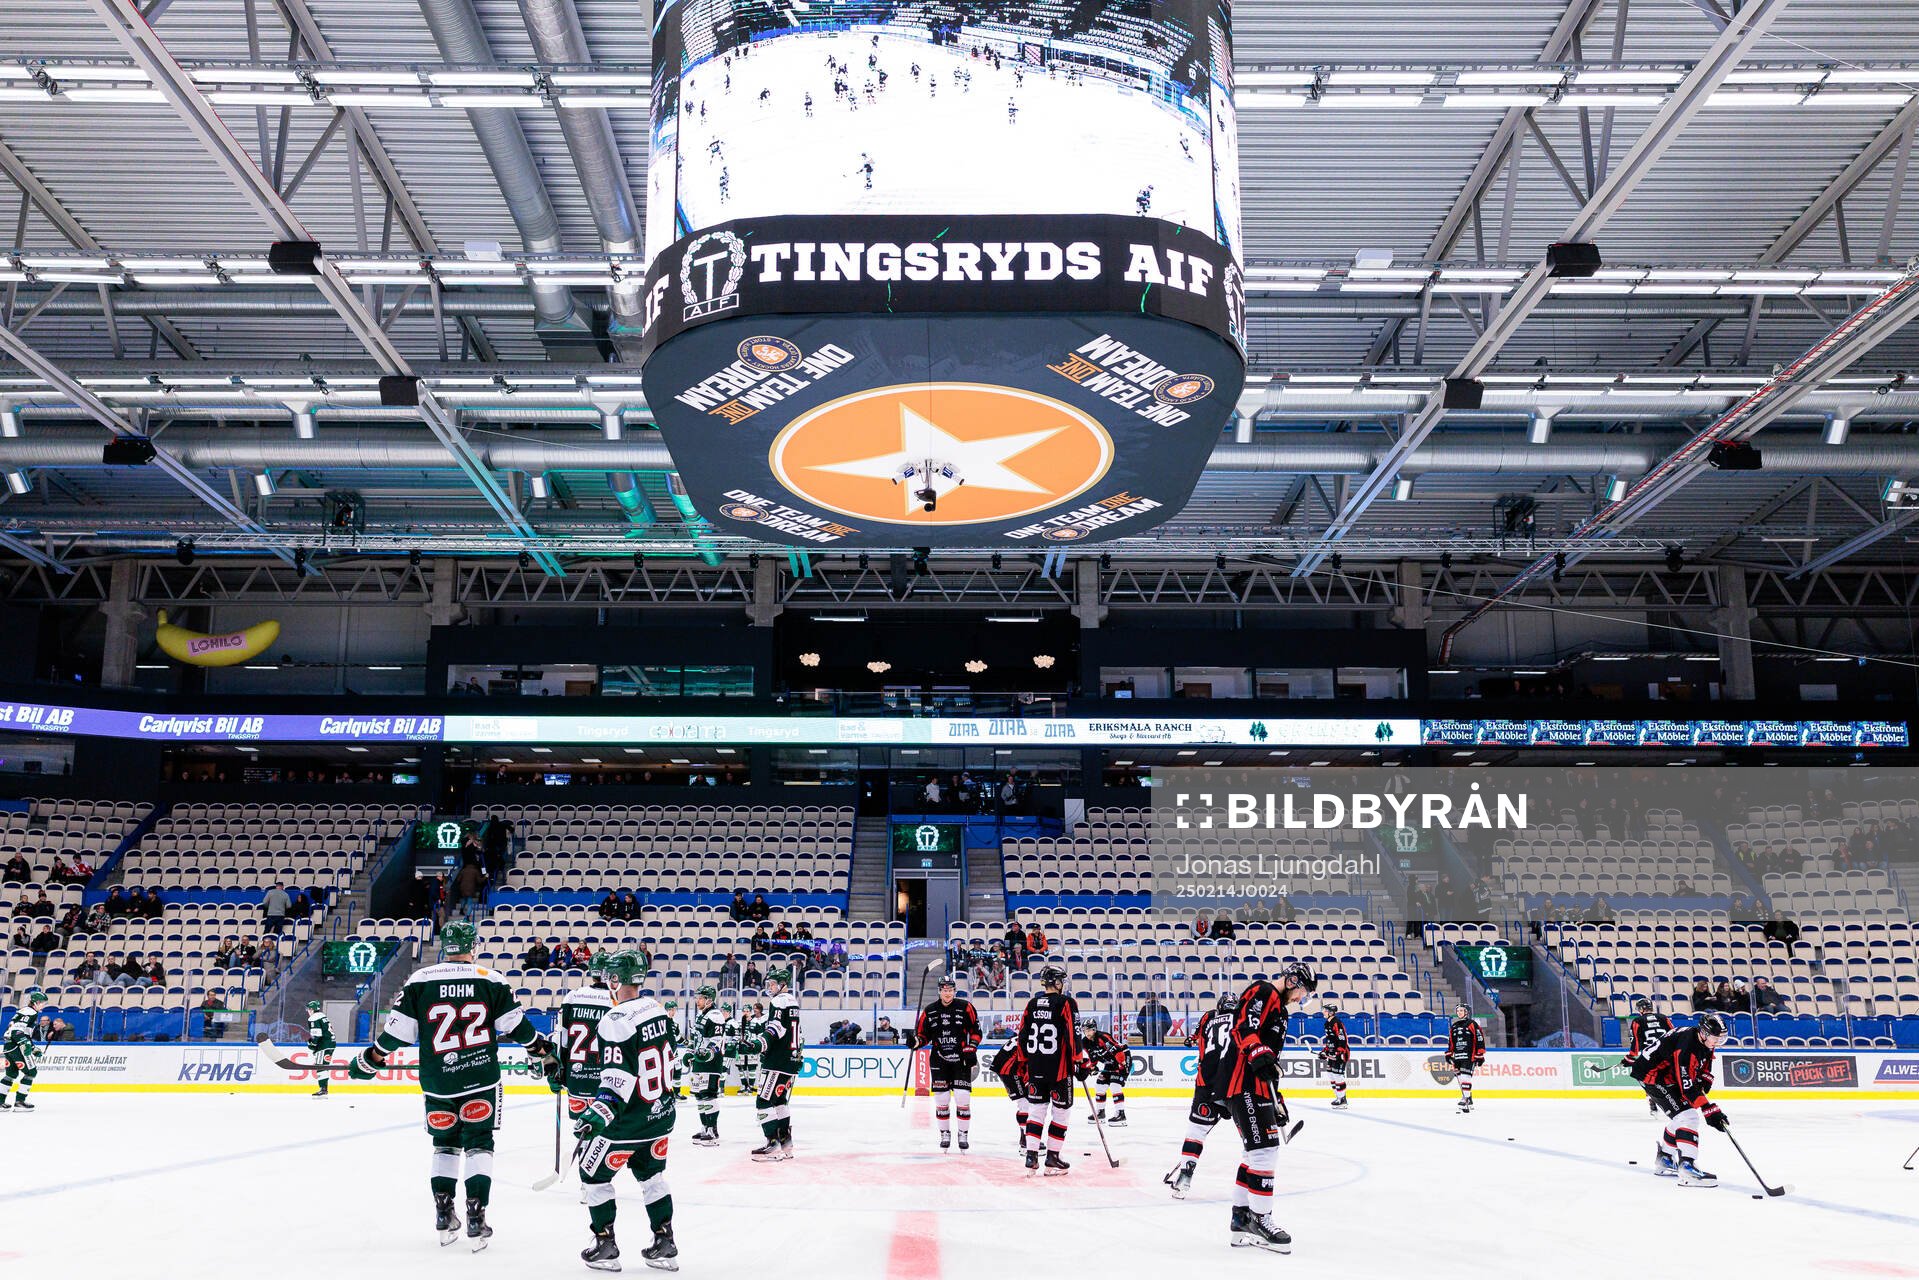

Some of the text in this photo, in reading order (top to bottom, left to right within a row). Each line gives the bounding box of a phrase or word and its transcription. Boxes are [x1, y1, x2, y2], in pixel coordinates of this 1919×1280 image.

[751, 242, 1213, 297] TINGSRYDS AIF
[690, 296, 731, 317] AIF
[795, 343, 855, 380] ONE
[1051, 354, 1099, 382] ONE
[1075, 333, 1178, 391] DREAM
[674, 359, 772, 412] DREAM
[738, 372, 811, 411] TEAM
[1080, 372, 1151, 410] TEAM
[714, 401, 755, 424] ONE
[1134, 401, 1191, 428] ONE
[722, 489, 776, 508] ONE
[770, 505, 831, 528] TEAM
[1071, 498, 1163, 530] DREAM
[757, 514, 841, 542] DREAM
[1003, 523, 1046, 539] ONE
[1043, 504, 1108, 526] TEAM
[191, 635, 243, 653] LOHILO
[15, 706, 43, 724] Bil
[46, 709, 75, 726] AB
[31, 724, 69, 732] TINGSRYD
[139, 716, 264, 736] Carlqvist Bil AB
[319, 717, 442, 737] Carlqvist Bil AB
[1155, 723, 1192, 732] RANCH
[1432, 722, 1473, 730] Ekströms
[1486, 722, 1527, 730] Ekströms
[1540, 722, 1581, 730] Ekströms
[1594, 722, 1635, 730] Ekströms
[1648, 722, 1689, 730] Ekströms
[1702, 723, 1743, 731] Ekströms
[1756, 723, 1797, 731] Ekströms
[1810, 723, 1851, 731] Ekströms
[1864, 724, 1904, 732] Ekströms
[1441, 731, 1473, 740] Möbler
[1495, 731, 1527, 740] Möbler
[1549, 731, 1581, 740] Möbler
[1603, 731, 1635, 740] Möbler
[1657, 732, 1689, 740] Möbler
[1712, 732, 1743, 741] Möbler
[1766, 732, 1797, 741] Möbler
[1820, 732, 1851, 741] Möbler
[1873, 733, 1904, 742] Möbler
[440, 984, 475, 998] BOHM
[428, 1002, 491, 1053] 22
[1026, 1022, 1059, 1055] 33
[53, 1056, 67, 1064] DET
[68, 1056, 93, 1064] STORA
[94, 1055, 127, 1065] HJÄRTAT
[604, 1046, 623, 1065] 86
[178, 1063, 254, 1081] KPMG
[441, 1057, 491, 1074] Tingsryd Resort
[637, 1040, 675, 1103] 86
[919, 1051, 927, 1085] CCM
[1131, 1055, 1163, 1076] DL
[1315, 1059, 1386, 1078] PDEL
[1757, 1061, 1812, 1071] SURFA
[1794, 1065, 1846, 1082] PUCK OFF
[1250, 1116, 1261, 1144] ENERGI
